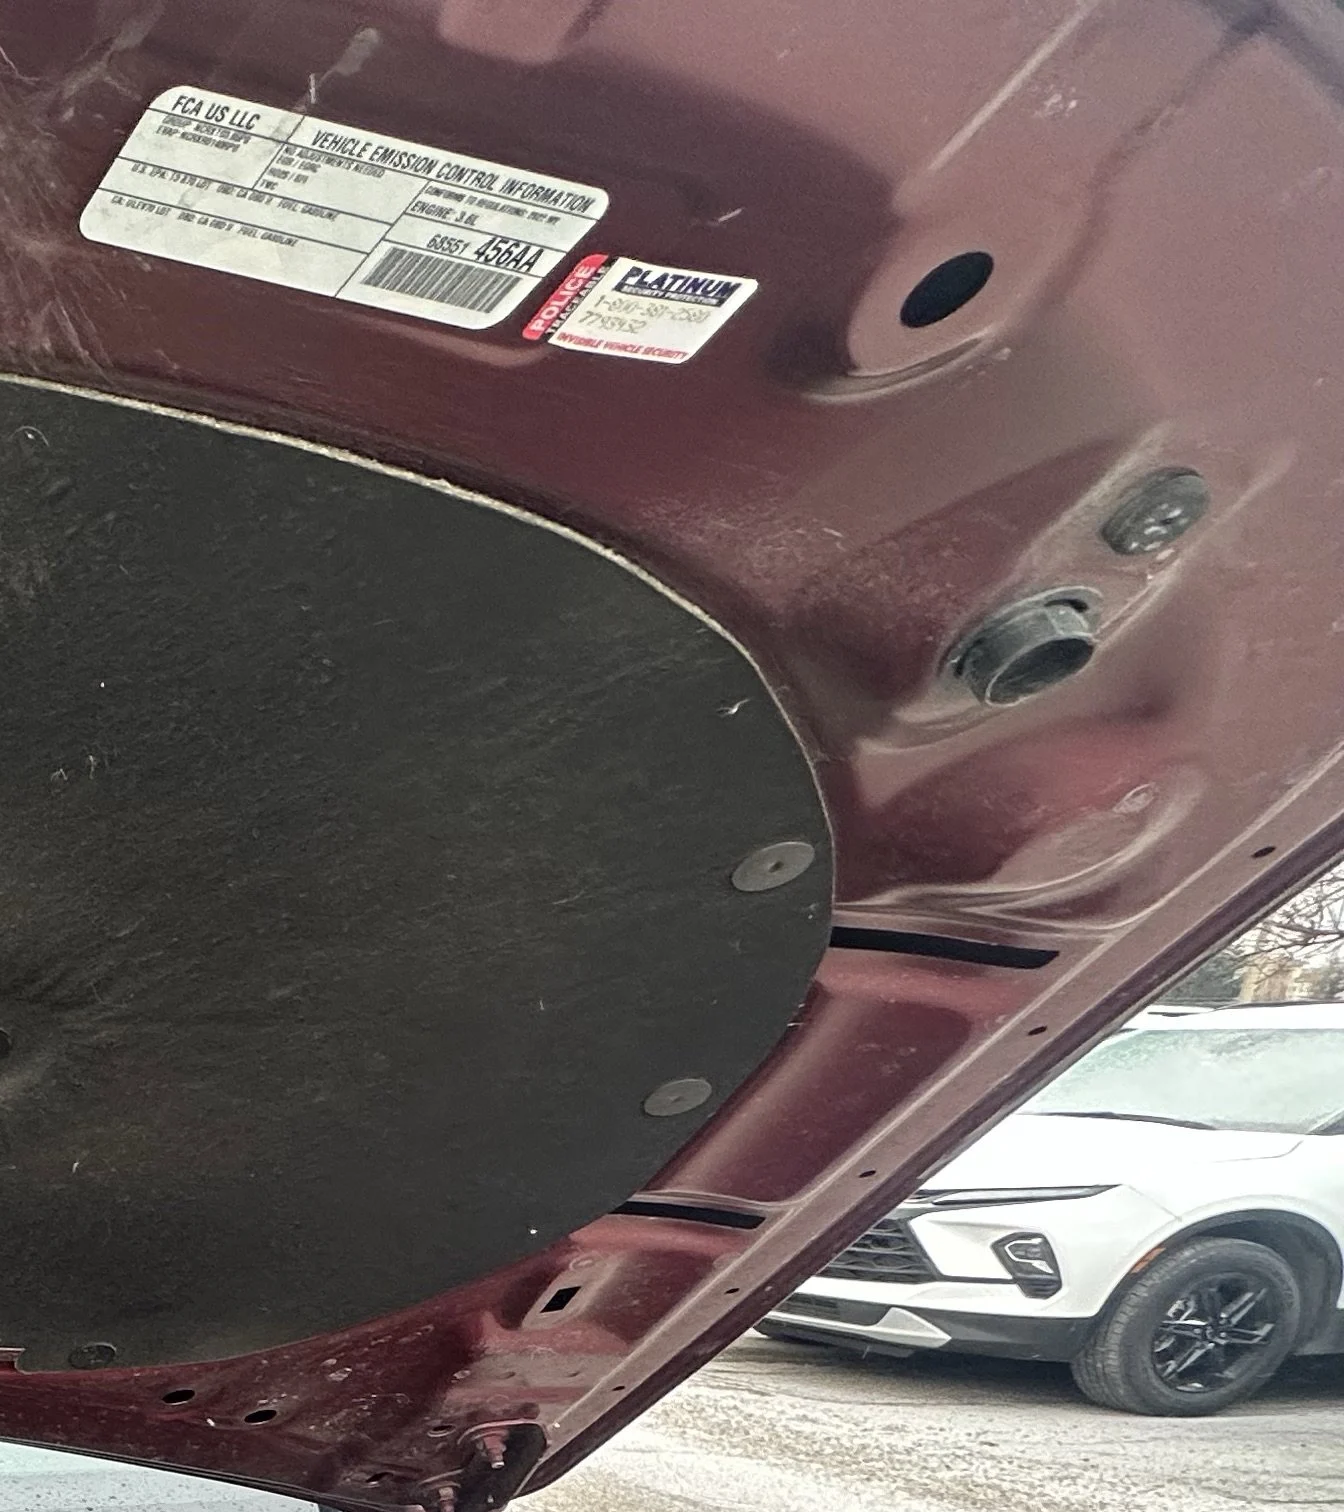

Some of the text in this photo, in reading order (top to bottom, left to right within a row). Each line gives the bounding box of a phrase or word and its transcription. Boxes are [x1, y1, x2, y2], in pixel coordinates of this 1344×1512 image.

[171, 94, 261, 131] FCA US LLC
[311, 129, 597, 214] VEHICLE EMISSION CONTROL INFORMATION
[473, 237, 547, 273] 456AA
[528, 263, 598, 334] POLICE
[618, 265, 743, 300] PLATINUM
[555, 330, 691, 362] INVISIBLE VEHICLE SECURITY
